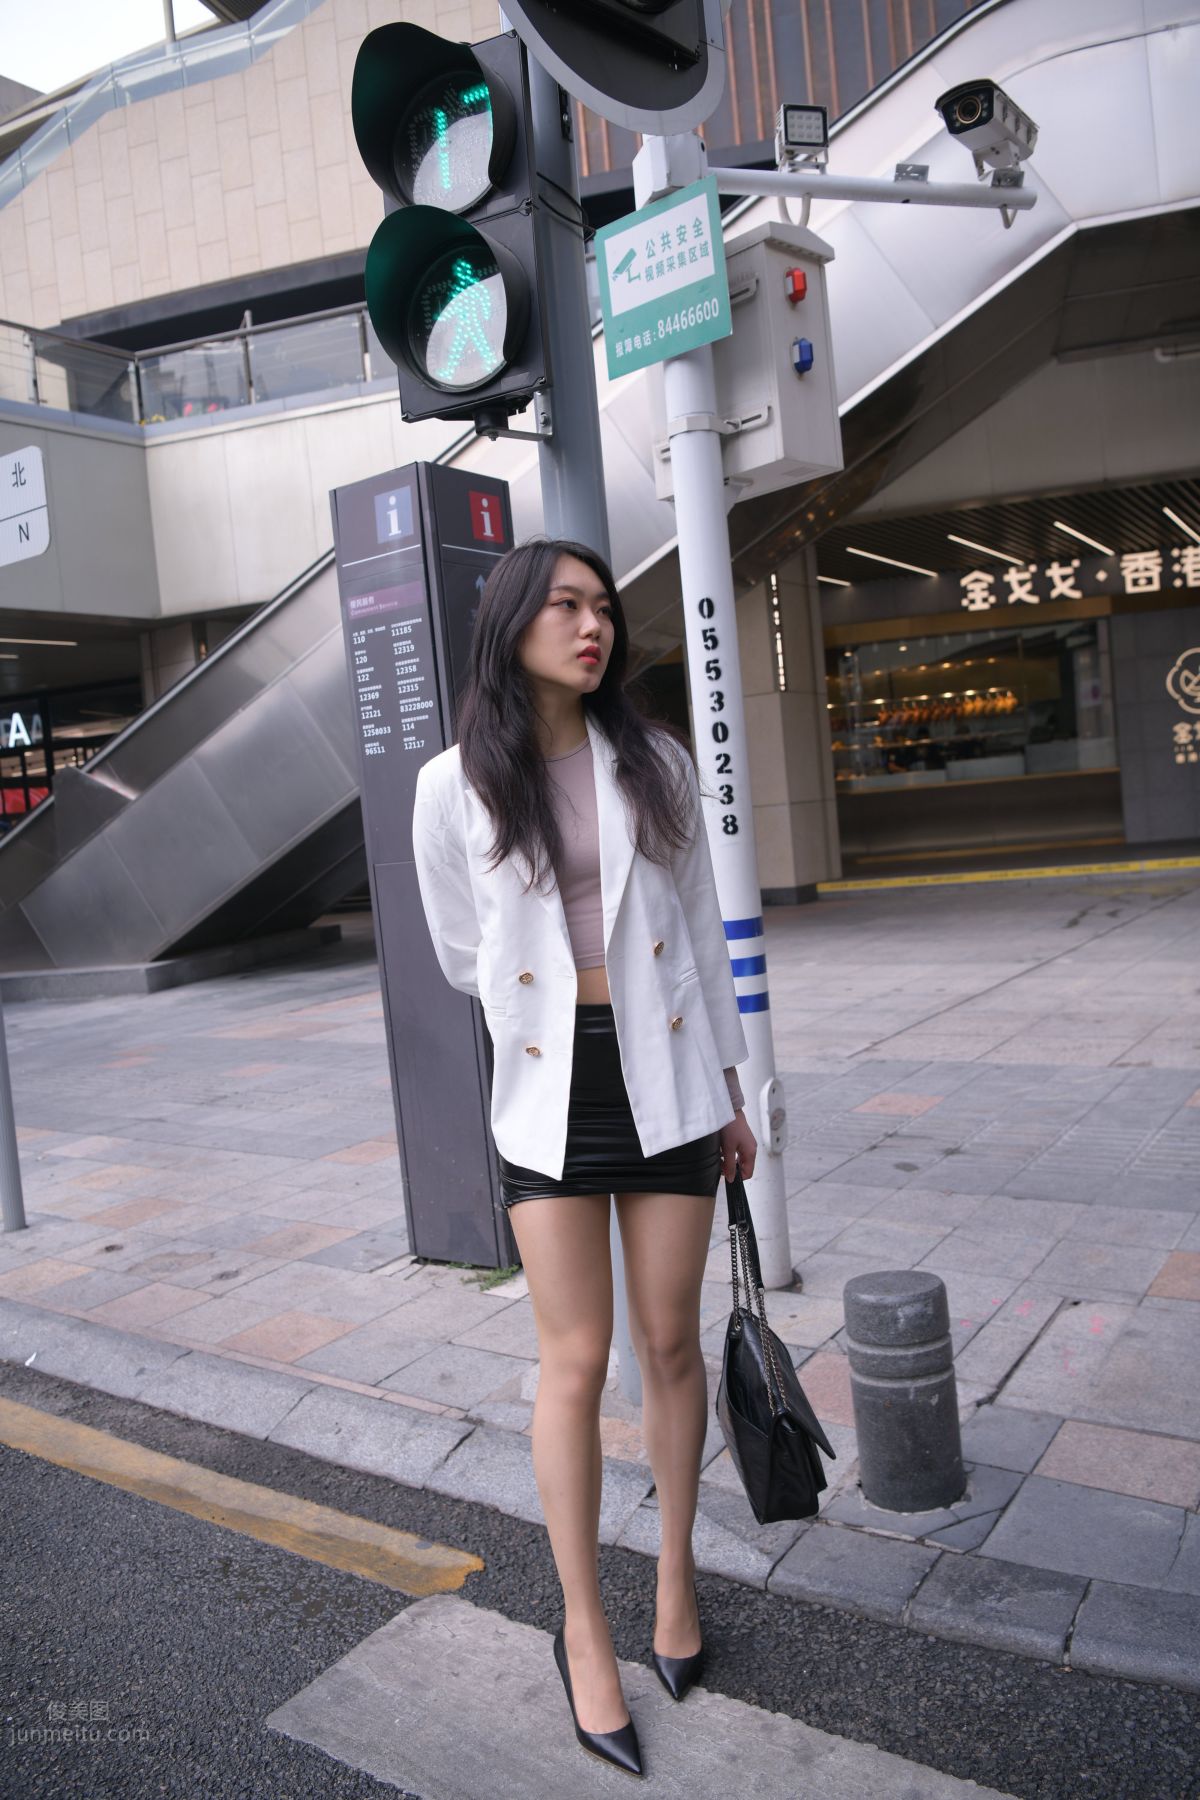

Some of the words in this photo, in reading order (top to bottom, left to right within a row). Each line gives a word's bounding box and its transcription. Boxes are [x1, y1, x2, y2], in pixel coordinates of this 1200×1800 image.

[646, 217, 704, 259] 公共安全
[645, 241, 709, 282] 视频采集区域
[12, 461, 26, 488] 北
[18, 522, 30, 543] N
[698, 597, 739, 836] 05530238
